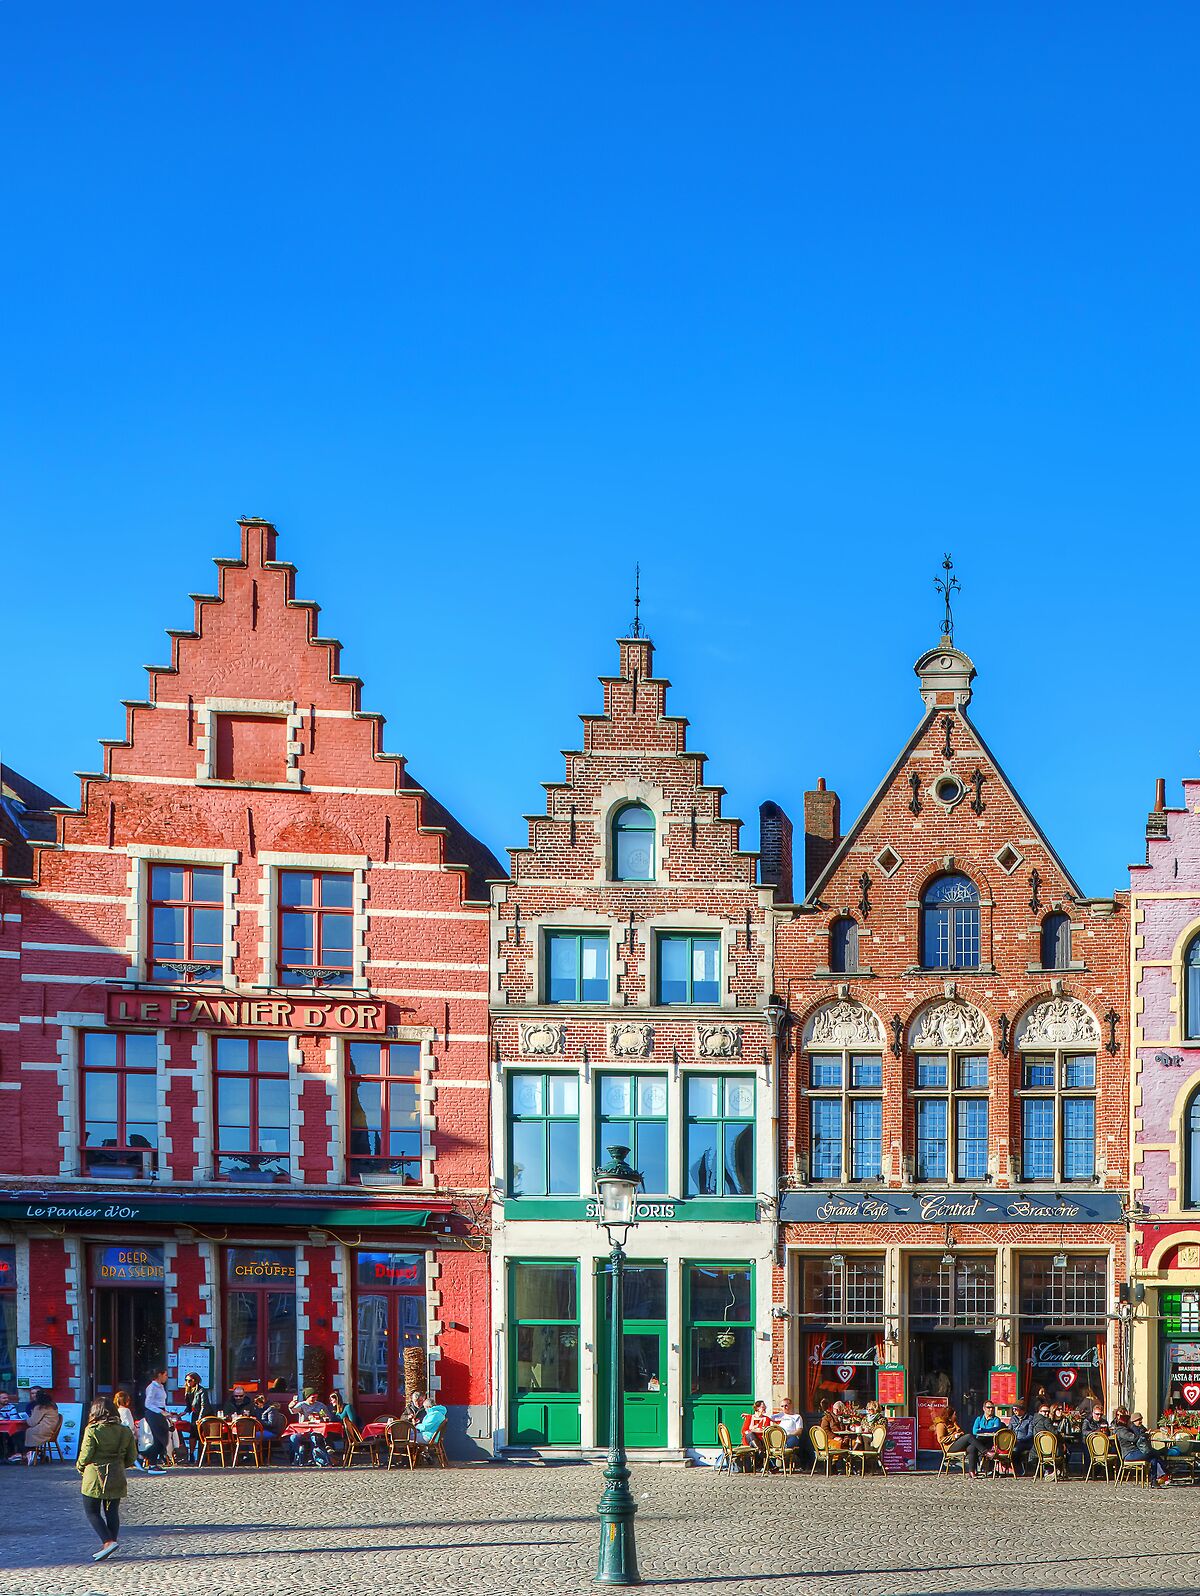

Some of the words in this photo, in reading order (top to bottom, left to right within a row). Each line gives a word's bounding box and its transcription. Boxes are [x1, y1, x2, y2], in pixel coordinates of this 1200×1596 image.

[118, 1001, 161, 1022] LE
[169, 998, 296, 1027] PANIER
[303, 1004, 381, 1029] D'OR
[26, 1205, 46, 1217] Le
[46, 1206, 102, 1218] Panier
[104, 1205, 140, 1218] d'Or
[816, 1201, 859, 1220] Grand
[919, 1194, 977, 1221] Central
[1007, 1201, 1080, 1218] Brasserie
[118, 1251, 148, 1264] BEER
[235, 1265, 296, 1277] CHOUFFE
[820, 1340, 874, 1360] Central
[1038, 1341, 1092, 1361] Central
[1170, 1373, 1187, 1381] PASTA
